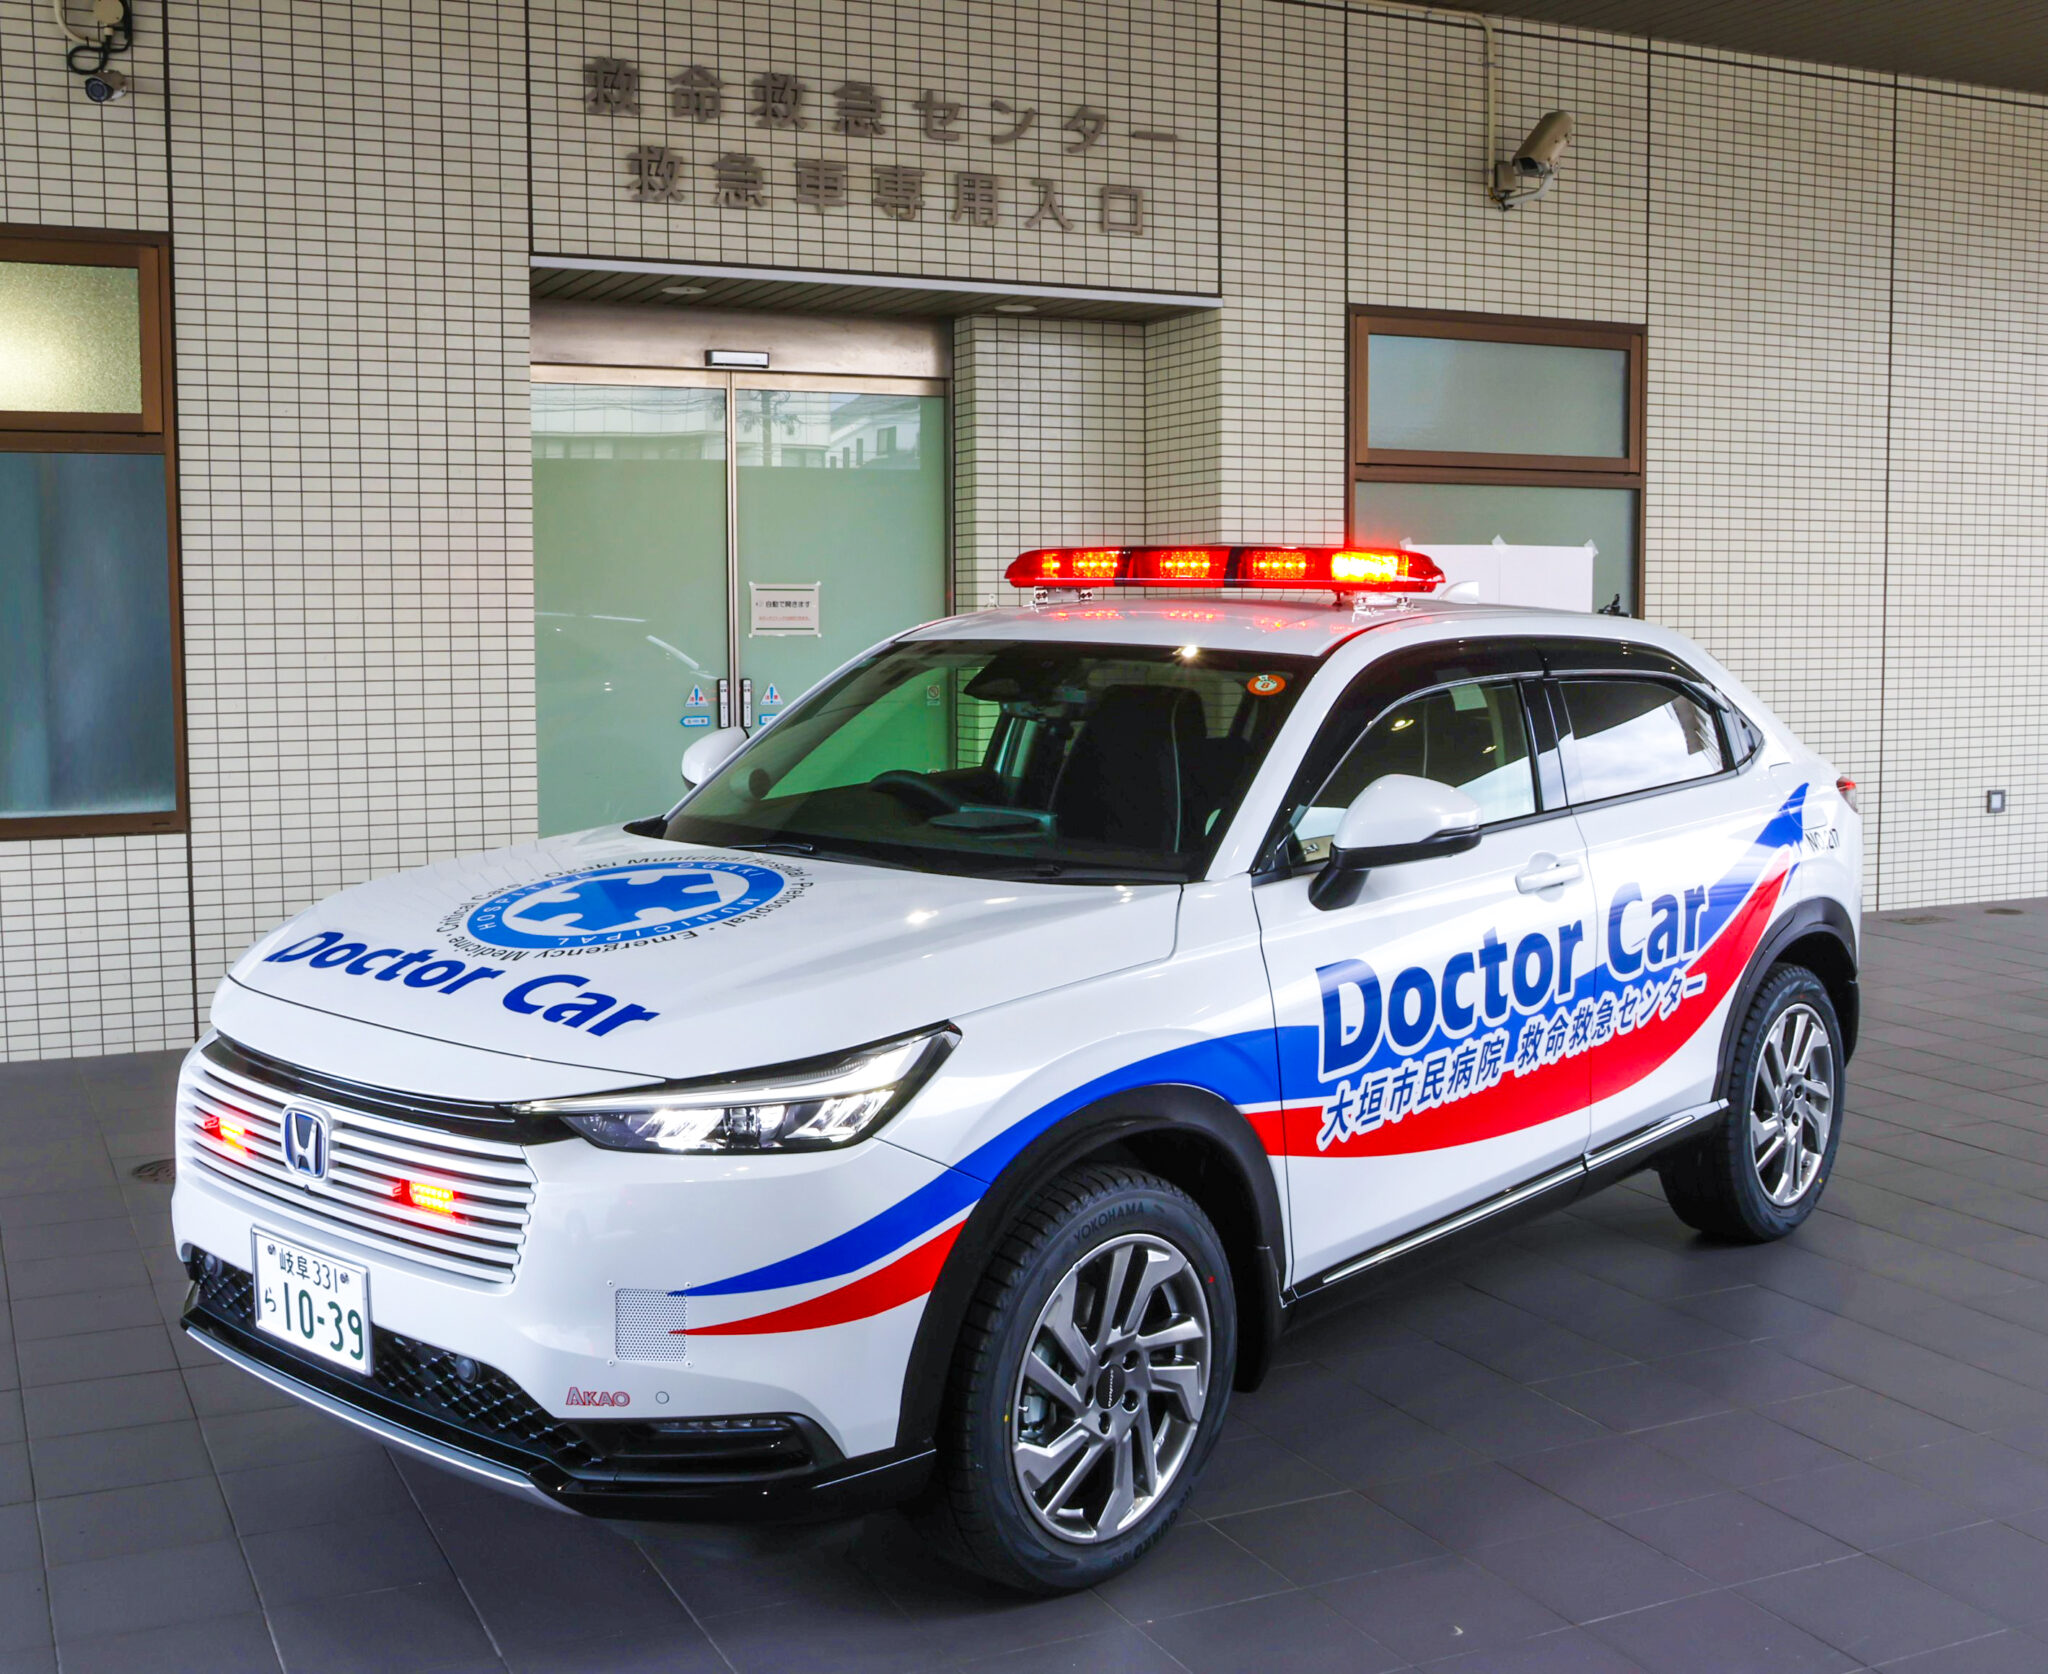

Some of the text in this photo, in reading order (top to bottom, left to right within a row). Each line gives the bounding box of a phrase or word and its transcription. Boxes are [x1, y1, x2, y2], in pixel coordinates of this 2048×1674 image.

[585, 57, 1179, 153] 救命救急センター
[626, 146, 1145, 236] 救急車専用入口
[545, 862, 616, 877] Ogaki
[628, 855, 750, 864] Municipal
[471, 883, 522, 901] Care
[477, 862, 765, 945] OGAKI MUNICIPAL HOSPITAL
[722, 882, 814, 928] Prehospital
[436, 901, 479, 933] Critical
[534, 930, 698, 959] Emergency
[264, 932, 661, 1037] Doctor Car
[1315, 882, 1706, 1074] Doctor Car
[1321, 1035, 1507, 1143] 大垣市民病院
[1516, 975, 1705, 1069] 救命救急センター
[1073, 1202, 1144, 1242] YOKOHAMA
[264, 1282, 364, 1361] ら 10-39
[565, 1386, 631, 1407] AKAO
